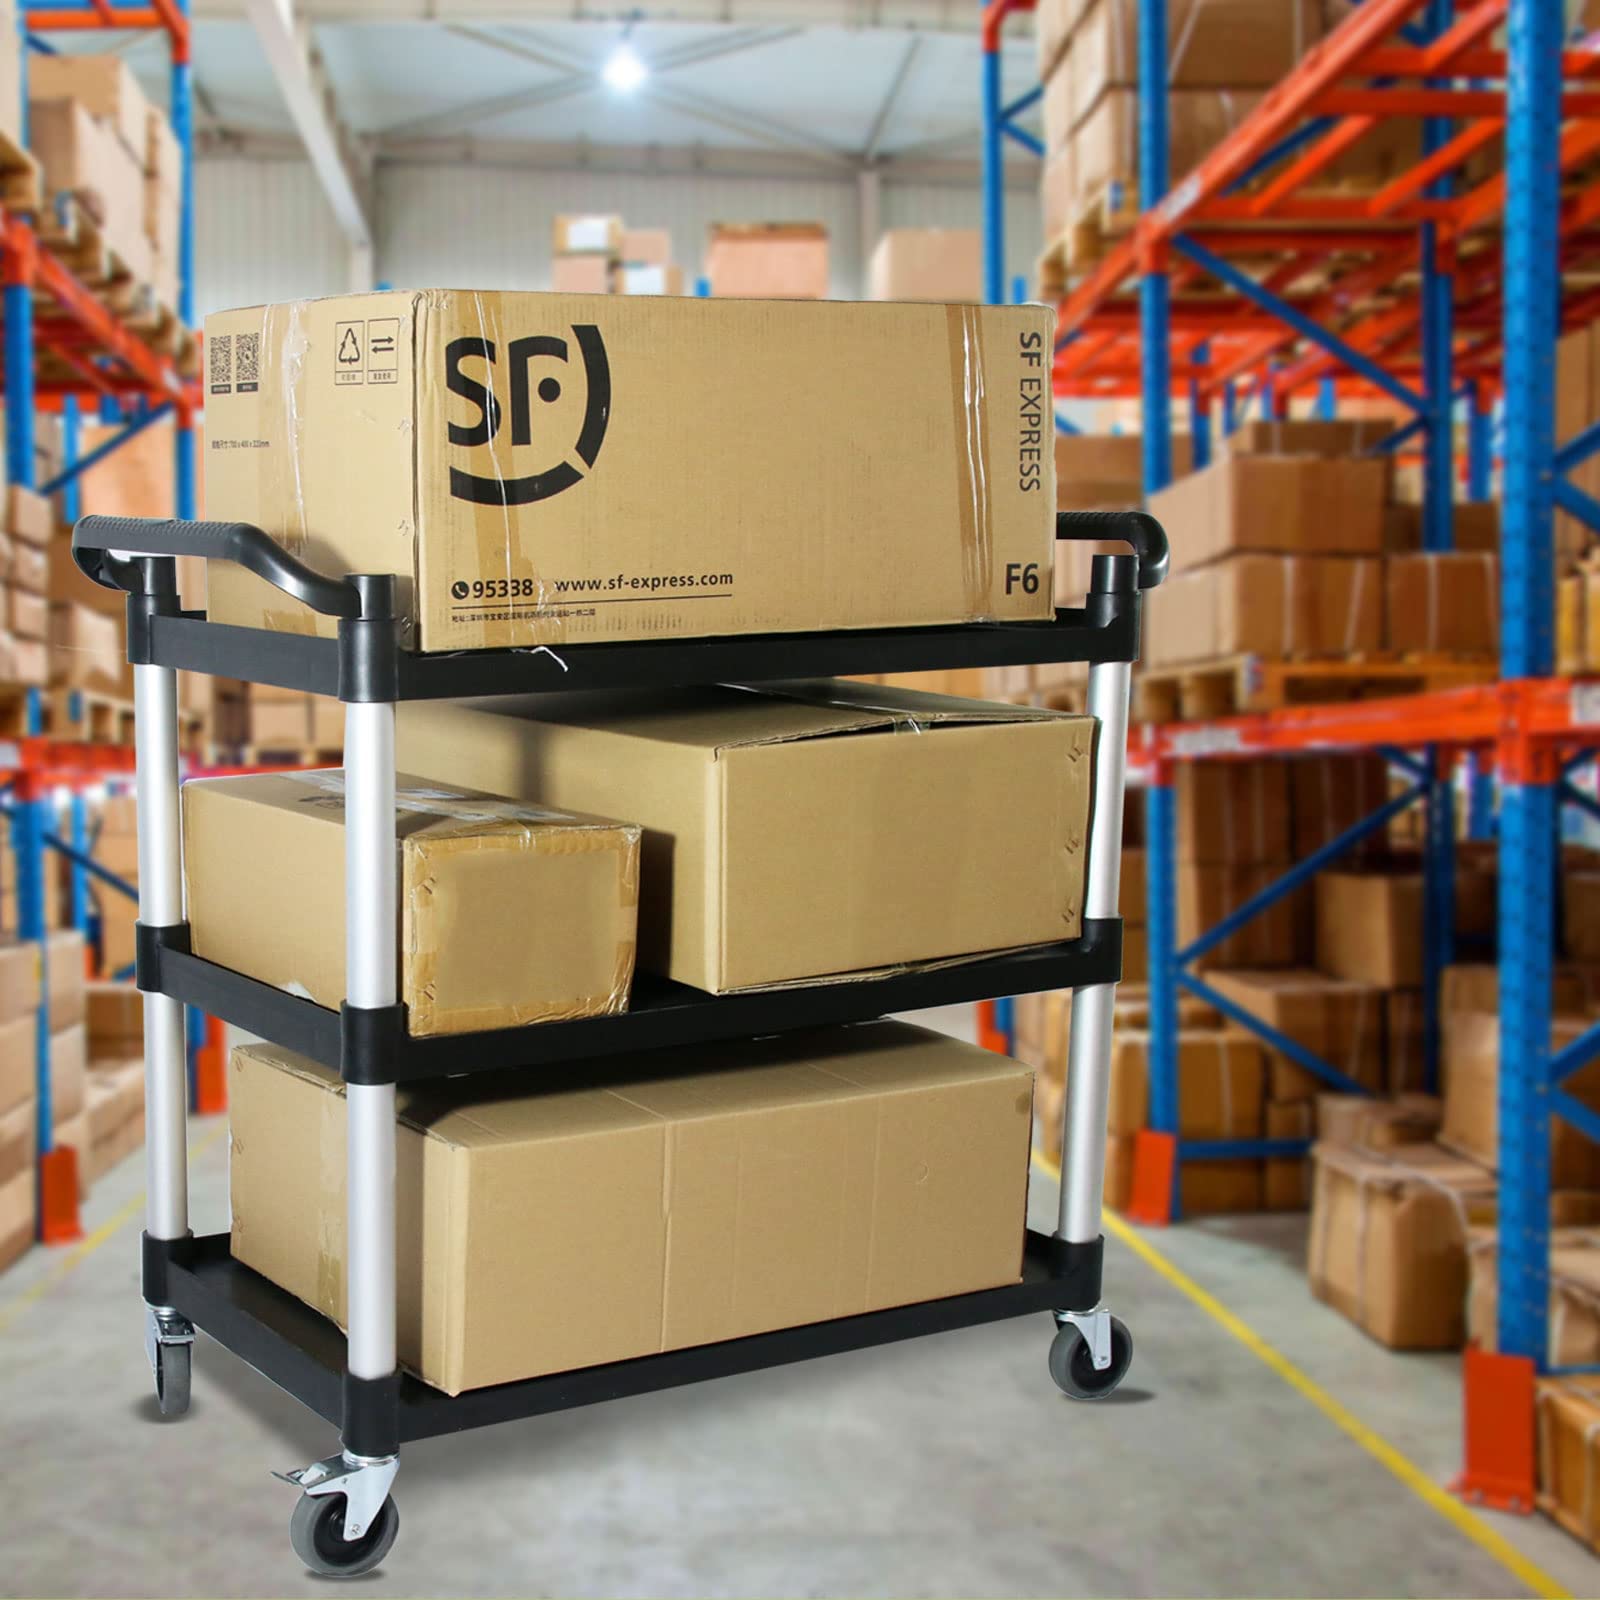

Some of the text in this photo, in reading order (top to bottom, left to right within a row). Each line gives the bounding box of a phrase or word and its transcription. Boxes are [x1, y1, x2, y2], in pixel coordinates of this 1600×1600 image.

[1019, 332, 1042, 492] SF EXPRESS
[472, 573, 733, 599] 95338 www.sf-express.com
[1005, 563, 1040, 596] F6
